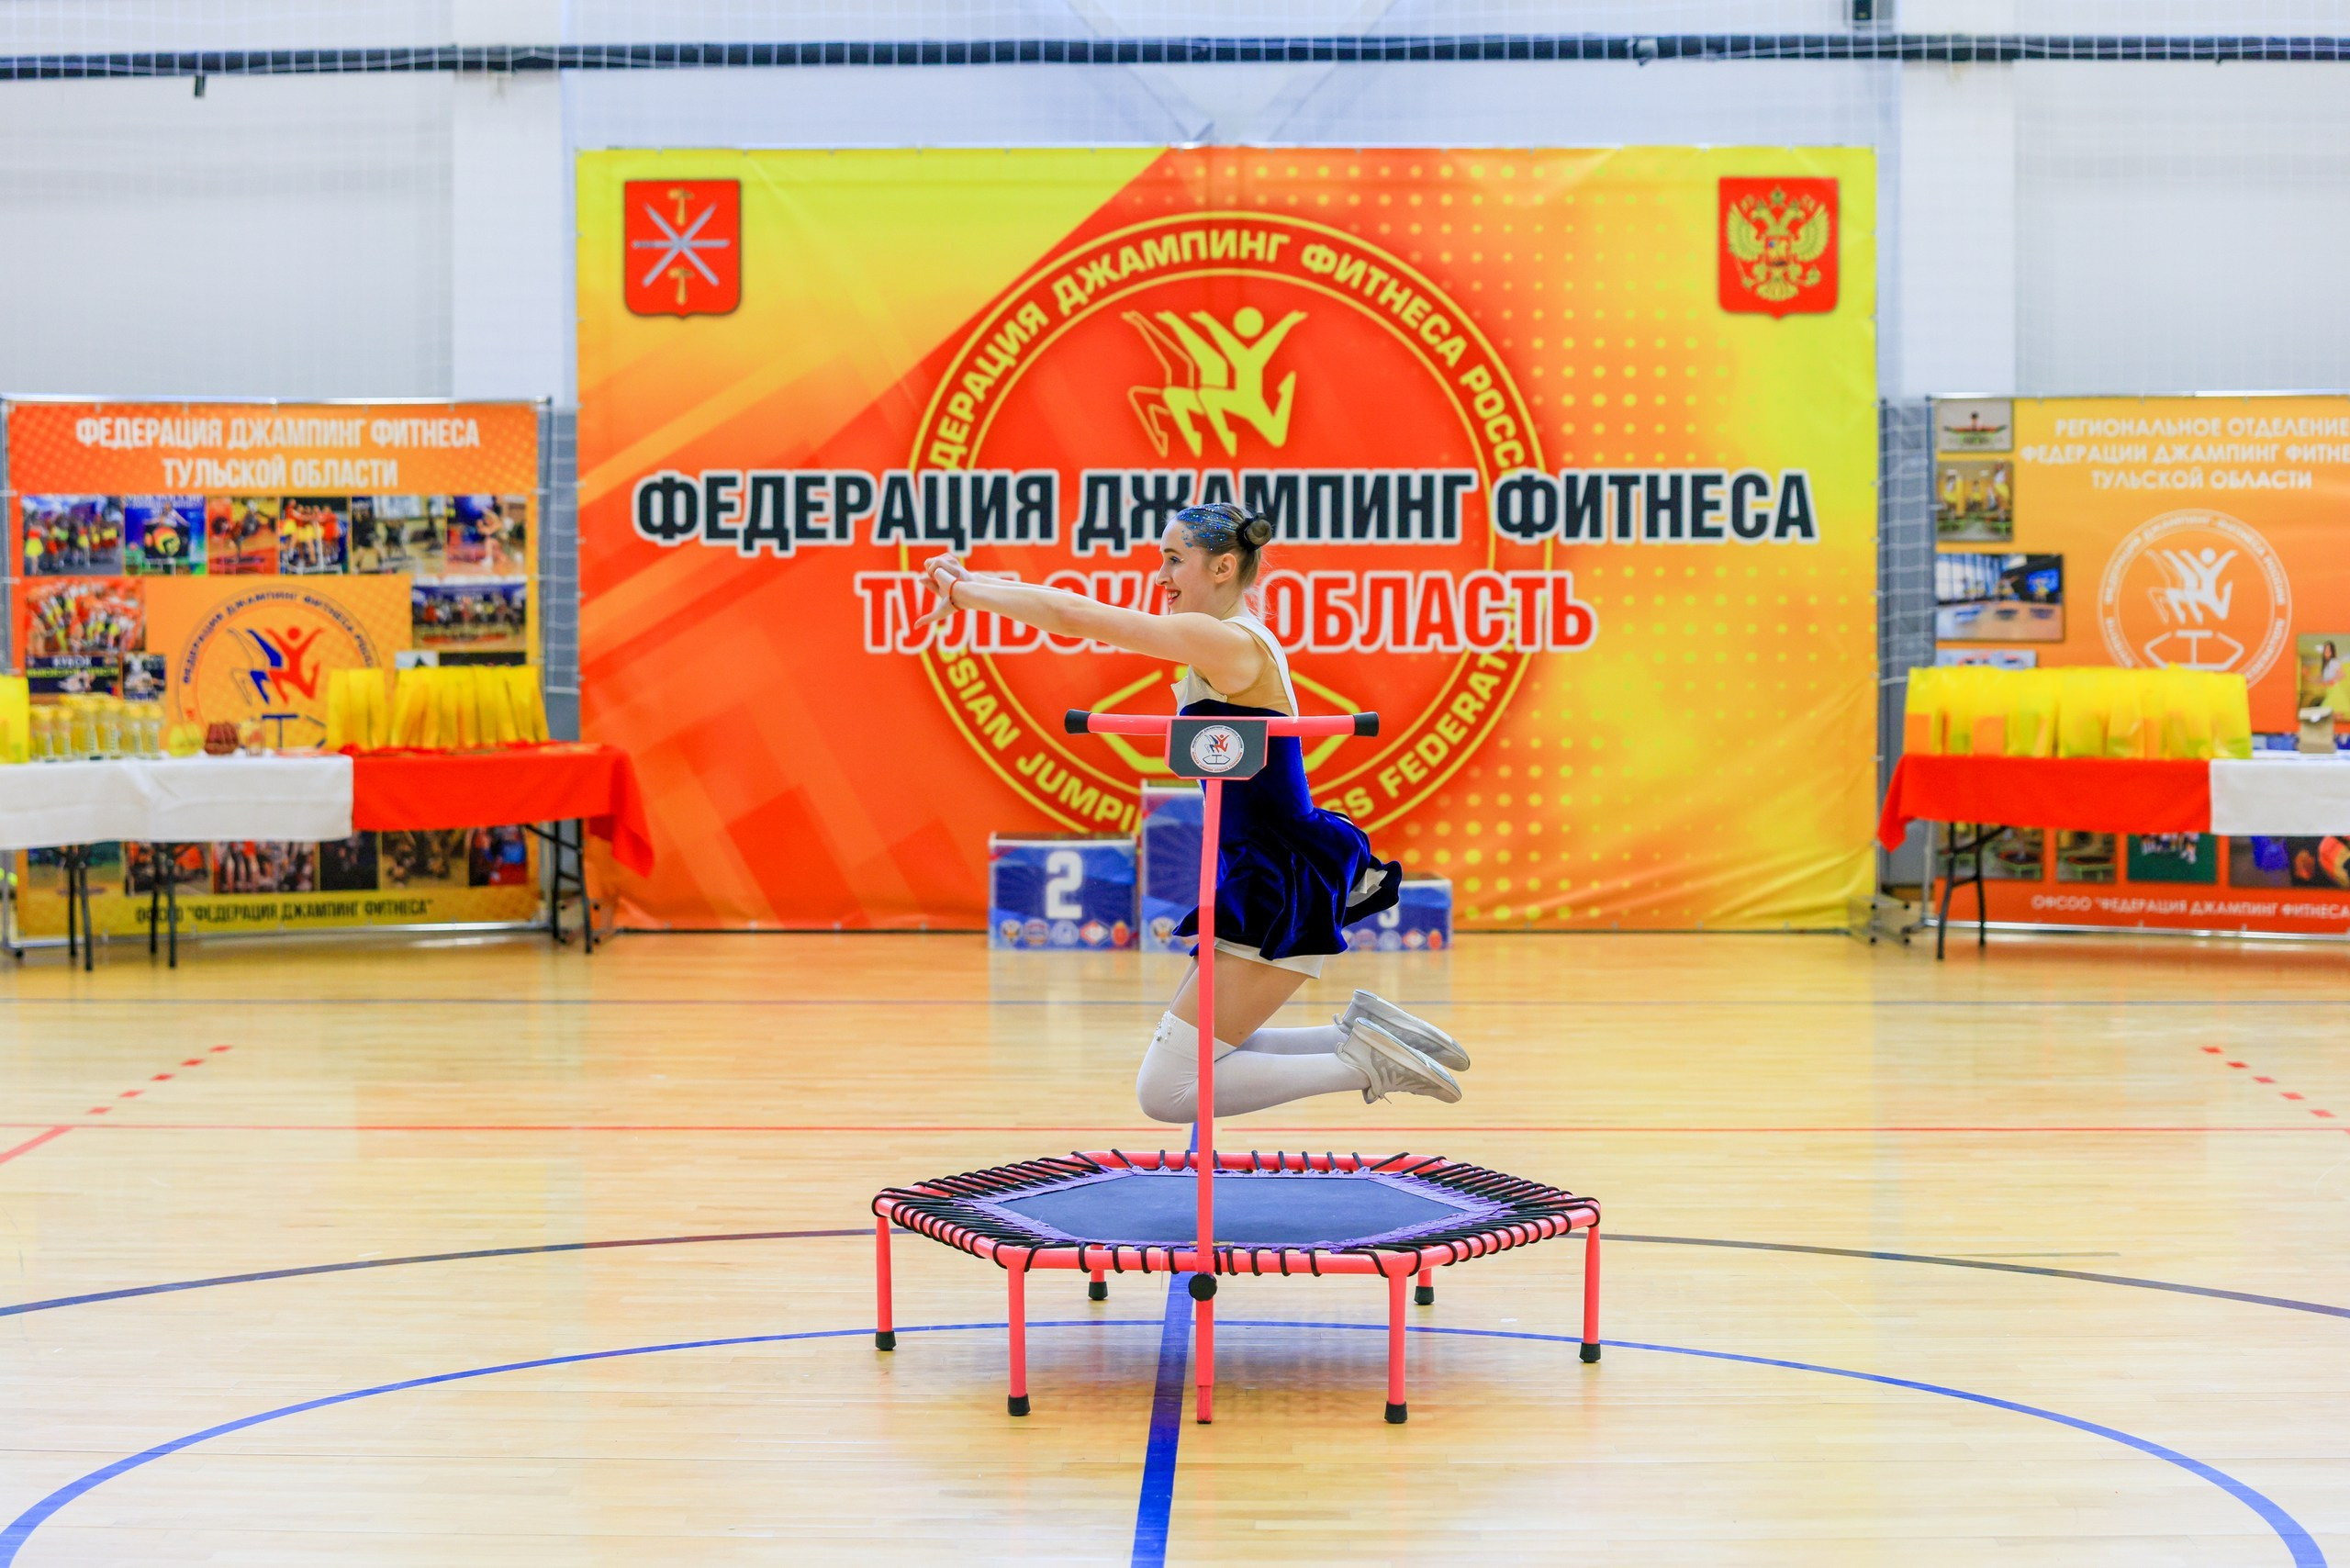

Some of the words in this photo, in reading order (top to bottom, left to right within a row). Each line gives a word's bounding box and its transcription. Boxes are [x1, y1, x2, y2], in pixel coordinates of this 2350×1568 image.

[928, 301, 1048, 471] ДЕРАЦИЯ
[1050, 229, 1291, 317] ДЖАМПИНГ
[1300, 243, 1469, 368] ФИТНЕСА
[1459, 364, 1528, 477] РОСС
[75, 418, 222, 450] ФЕДЕРАЦИЯ
[228, 419, 365, 450] ДЖАМПИНГ
[370, 418, 479, 449] ФИТНЕСА
[2055, 418, 2221, 438] РЕГИОНАЛЬНОЕ
[2227, 417, 2350, 439] ОТДЕЛЕНИЕ
[2021, 443, 2147, 465] ФЕДЕРАЦИИ
[2153, 442, 2280, 464] ДЖАМПИНГ
[2286, 443, 2350, 464] ФИТНЕ
[162, 454, 287, 488] ТУЛЬСКОЙ
[292, 459, 398, 488] ОБЛАСТИ
[2090, 466, 2203, 489] ТУЛЬСКОЙ
[2210, 469, 2312, 489] ОБЛАСТИ
[633, 468, 1059, 556] ФЕДЕРАЦИЯ
[1494, 468, 1819, 545] ФИТНЕСА
[1259, 570, 1597, 653] ОБЛАСТЬ
[1378, 640, 1515, 799] FEDERAT
[937, 645, 1022, 752] SIAN
[1015, 751, 1142, 834] JUMPI
[1045, 850, 1083, 920] 2
[281, 901, 359, 922] ДЖАМПИНГ
[2189, 899, 2278, 916] ДЖАМПИНГ
